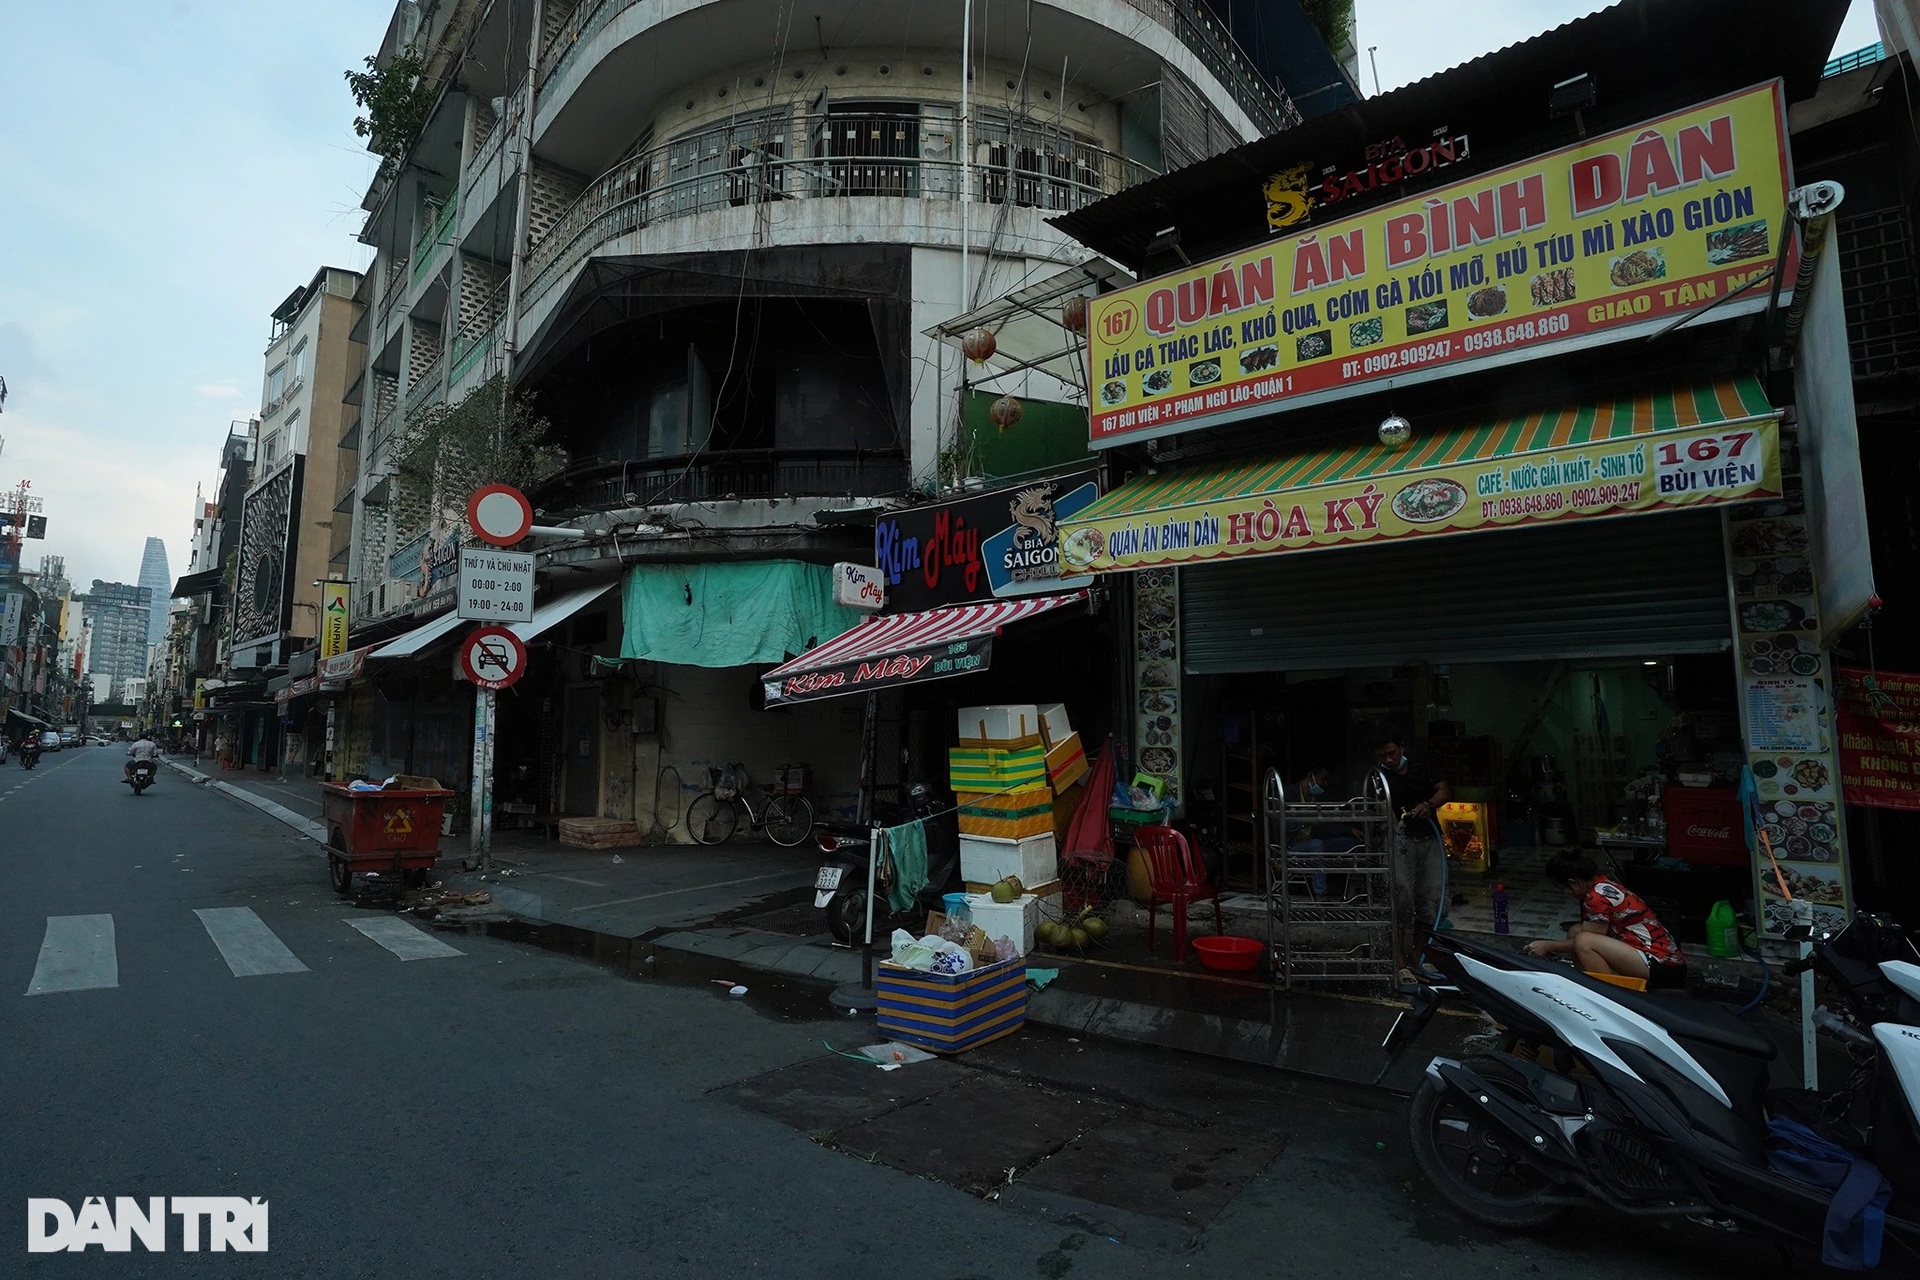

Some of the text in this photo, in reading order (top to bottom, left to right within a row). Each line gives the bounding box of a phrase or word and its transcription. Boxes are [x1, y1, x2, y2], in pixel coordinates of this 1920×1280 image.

[1365, 136, 1406, 161] BIA
[1321, 136, 1457, 203] SAIGON
[1145, 115, 1737, 337] QUÁN ĂN BÌNH DÂN
[1105, 186, 1754, 380] LẨU CÁ THÁC LÁC, KHỔ QUA, CƠM GÀ XỐI MỠ, HỦ TÍU MÌ XÀO GIÒN
[1587, 294, 1652, 324] GIAO
[1660, 280, 1716, 308] TẬN
[1103, 309, 1132, 338] 167
[1342, 362, 1361, 379] ĐT:
[1364, 340, 1450, 374] 0902.909247
[1464, 313, 1569, 353] 0938.648.860
[1101, 416, 1117, 432] 167
[1119, 410, 1136, 428] BÙI
[1138, 405, 1159, 424] VIỆN
[1175, 399, 1203, 415] PHẠM
[1206, 391, 1228, 409] NGŨ
[1286, 376, 1292, 391] 1
[1658, 431, 1753, 466] 167
[1478, 468, 1502, 495] CAFÉ
[1511, 464, 1538, 491] NƯỚC
[1540, 457, 1560, 487] GIẢI
[1563, 456, 1591, 484] KHÁT
[1601, 455, 1626, 479] SINH
[1628, 444, 1644, 474] TỐ
[1660, 461, 1756, 494] BÙI VIỆN
[1226, 484, 1388, 546] HÒA KÝ
[1482, 501, 1497, 519] ĐT:
[1500, 491, 1562, 516] 0938.648.860
[1572, 482, 1641, 508] 0902.909.247
[877, 509, 980, 593] Kim Mây
[1025, 538, 1043, 549] BIA
[1108, 512, 1219, 559] QUÁN ĂN BÌNH DÂN
[464, 556, 478, 569] THỨ
[480, 559, 485, 569] 7
[486, 558, 496, 571] VÀ
[498, 558, 512, 572] CHỦ
[513, 562, 531, 575] NHẬT
[1004, 547, 1059, 568] SAIGON
[472, 579, 495, 591] 00:00
[505, 581, 522, 592] 2:00
[846, 566, 866, 584] Kim
[469, 598, 491, 610] 19:00
[501, 602, 524, 613] 24:00
[861, 582, 882, 604] Mây
[934, 654, 981, 673] BÙI VIỆN
[948, 641, 968, 655] 165
[784, 672, 846, 696] Kim
[852, 655, 932, 684] Mây
[1842, 733, 1873, 751] Khách
[1860, 755, 1908, 773] KHÔNG
[1843, 775, 1861, 787] Mọi
[1864, 775, 1882, 787] liên
[1885, 777, 1897, 791] hệ
